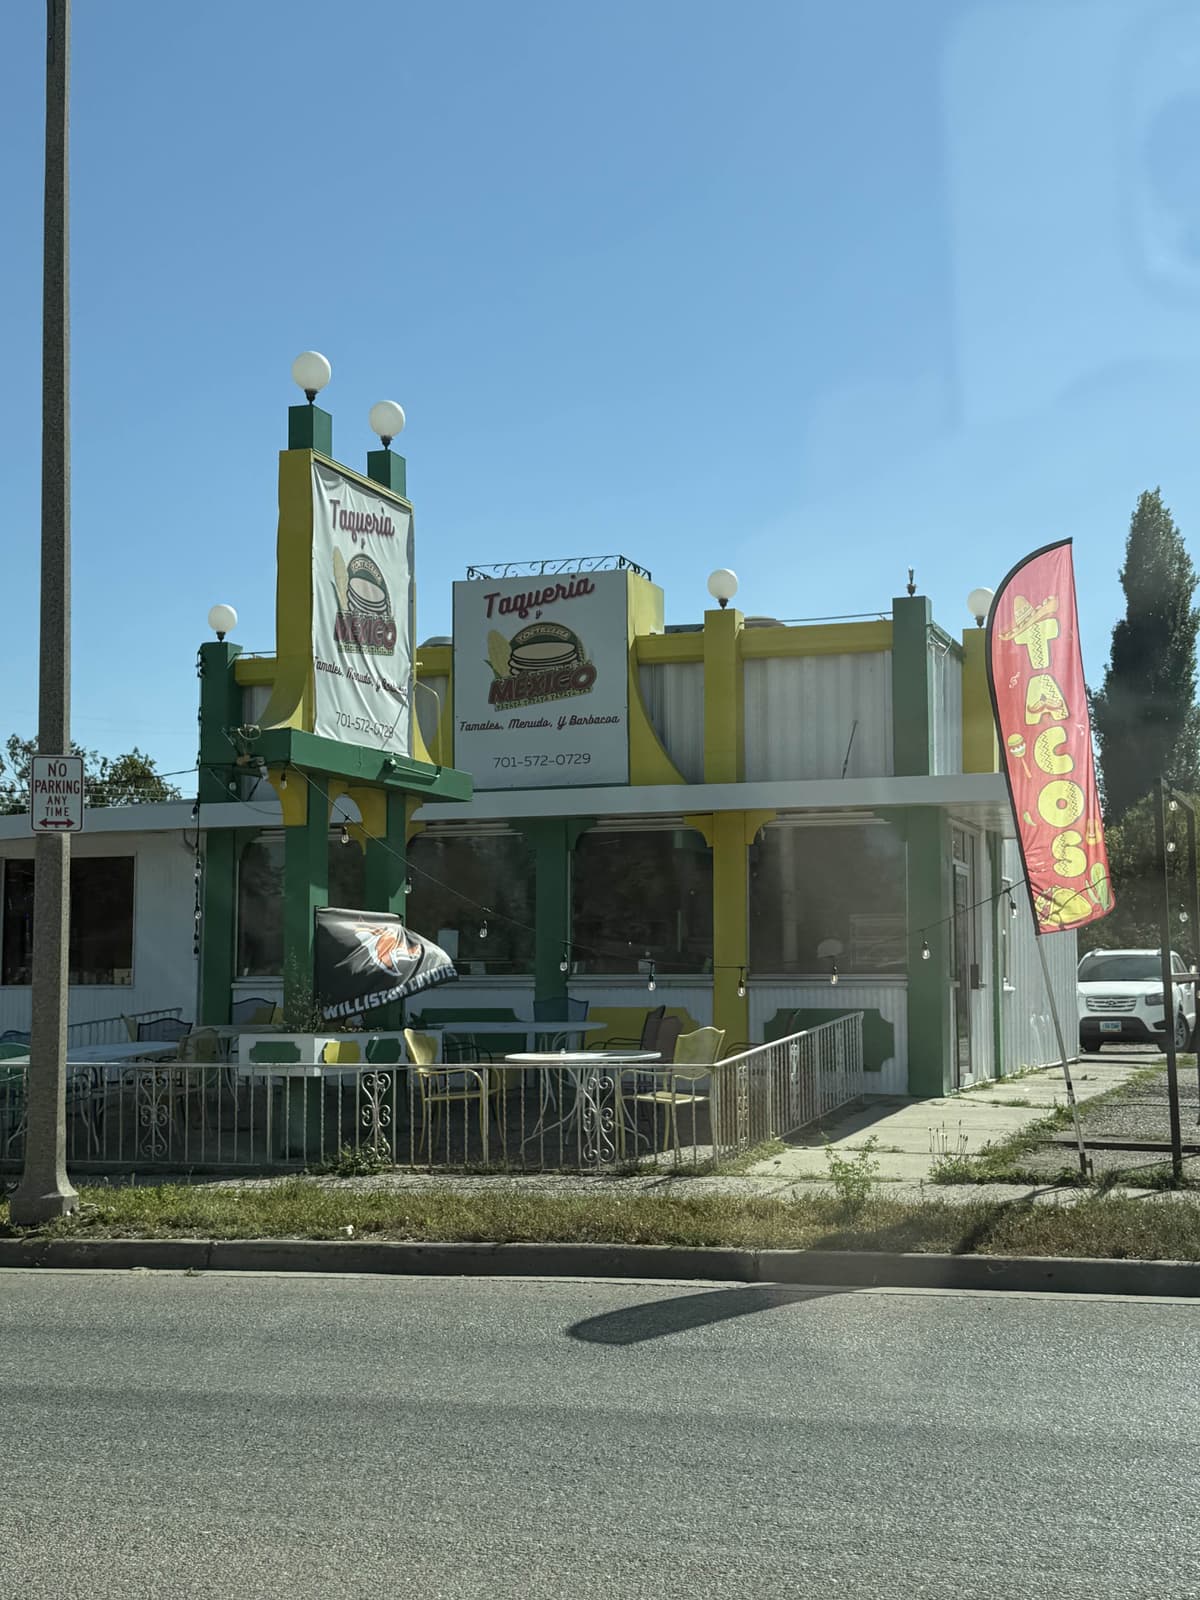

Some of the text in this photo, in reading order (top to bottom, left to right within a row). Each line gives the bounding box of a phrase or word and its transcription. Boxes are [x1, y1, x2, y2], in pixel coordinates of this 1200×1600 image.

[329, 499, 395, 544] Taqueria
[483, 574, 595, 619] Taqueria
[459, 720, 504, 732] Tamales,
[508, 717, 553, 729] Menudo,
[569, 713, 621, 726] Barbacoa
[1012, 617, 1088, 879] TACOS
[493, 753, 591, 768] 701-572-0729
[48, 763, 67, 777] NO
[34, 780, 80, 794] PARKING
[47, 795, 68, 805] ANY
[44, 806, 70, 817] TIME
[322, 964, 459, 1020] WILLISTON COYOTES
